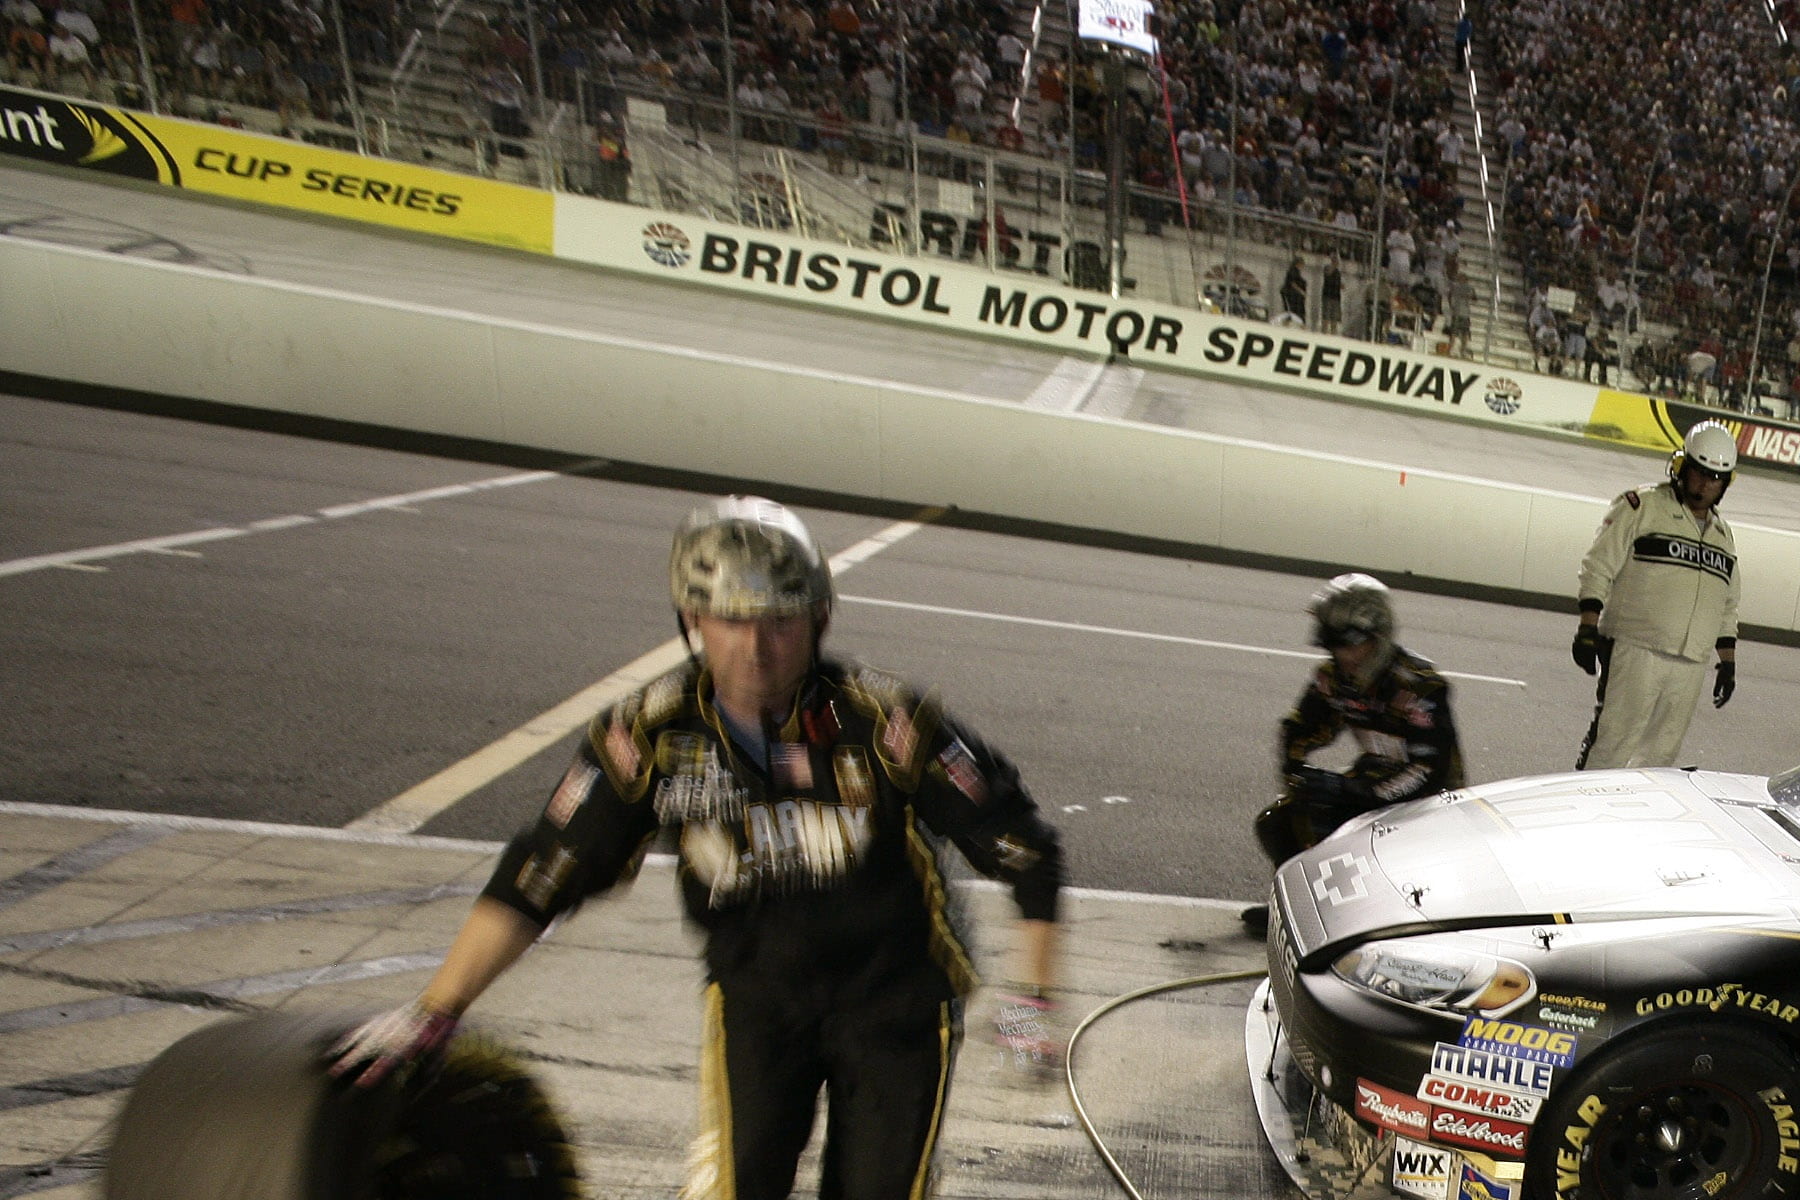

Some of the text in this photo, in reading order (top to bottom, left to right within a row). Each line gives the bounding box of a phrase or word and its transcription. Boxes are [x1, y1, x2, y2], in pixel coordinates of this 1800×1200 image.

[194, 147, 292, 183] CUP
[301, 167, 464, 218] SERIES
[699, 233, 1481, 406] BRISTOL MOTOR SPEEDWAY
[1668, 541, 1729, 574] OFFICIAL
[1636, 983, 1799, 1023] GOODYEAR
[1463, 1018, 1576, 1055] MOOG
[1464, 1037, 1567, 1067] CHASSIS PARTS
[1425, 1079, 1512, 1111] COMP
[1482, 1105, 1523, 1119] CAMS
[1432, 1111, 1526, 1151] Edelbrock
[1758, 1085, 1800, 1175] EAGLE
[1396, 1150, 1445, 1176] WIX
